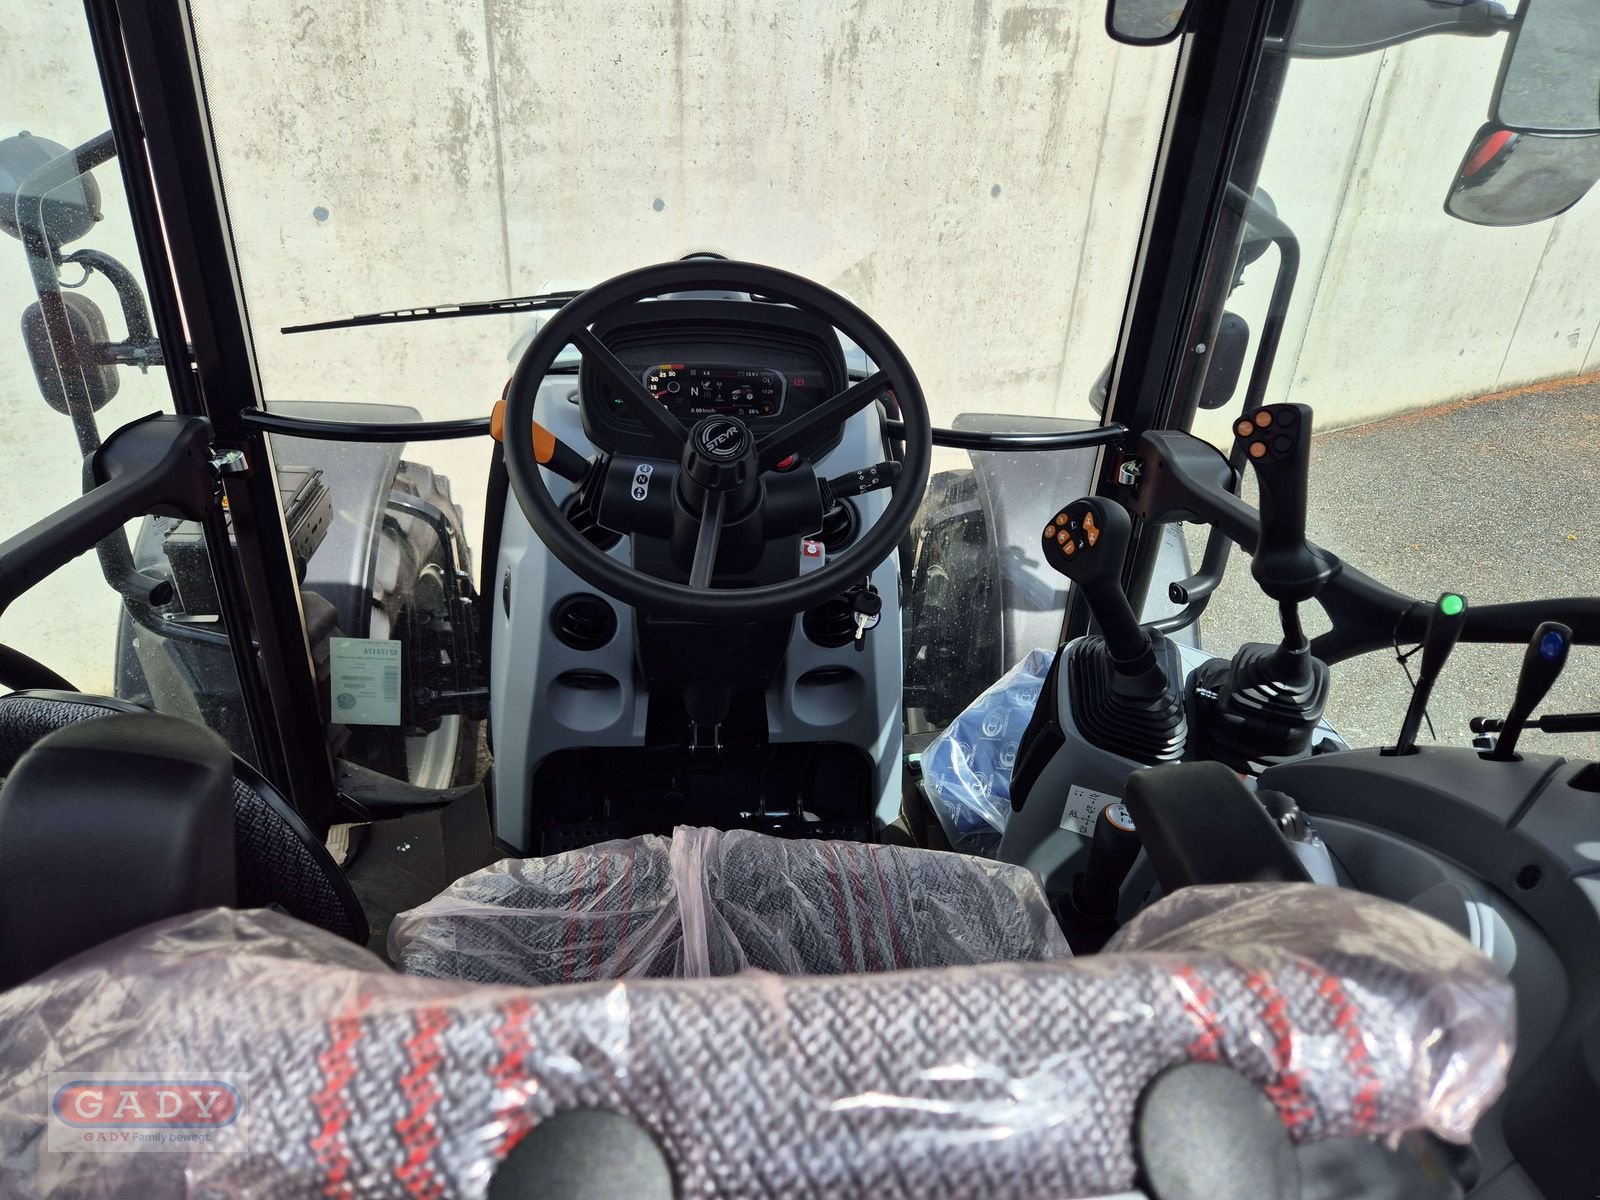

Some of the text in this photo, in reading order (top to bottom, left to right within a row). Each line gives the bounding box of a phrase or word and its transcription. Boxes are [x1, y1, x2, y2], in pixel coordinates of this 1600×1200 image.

[690, 387, 699, 397] N
[705, 426, 739, 451] STEYR
[638, 475, 646, 483] N
